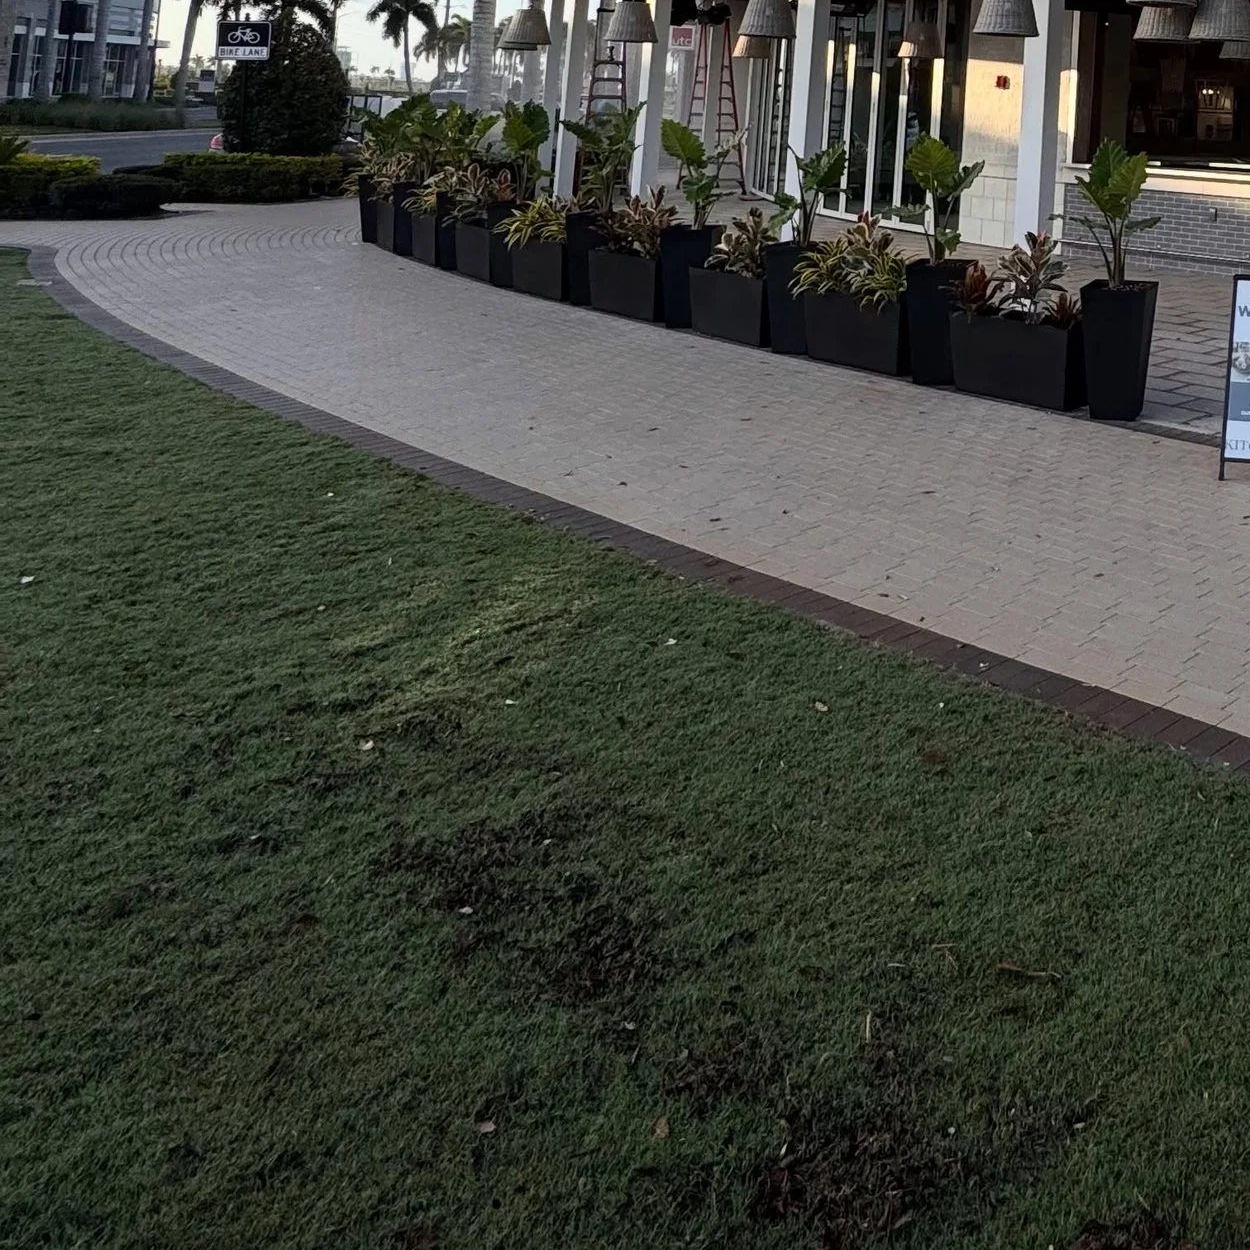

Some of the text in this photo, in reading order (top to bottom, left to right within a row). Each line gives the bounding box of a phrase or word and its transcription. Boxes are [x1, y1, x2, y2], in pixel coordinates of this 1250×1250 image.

[672, 36, 692, 46] utc
[220, 48, 265, 56] BIKE LANE
